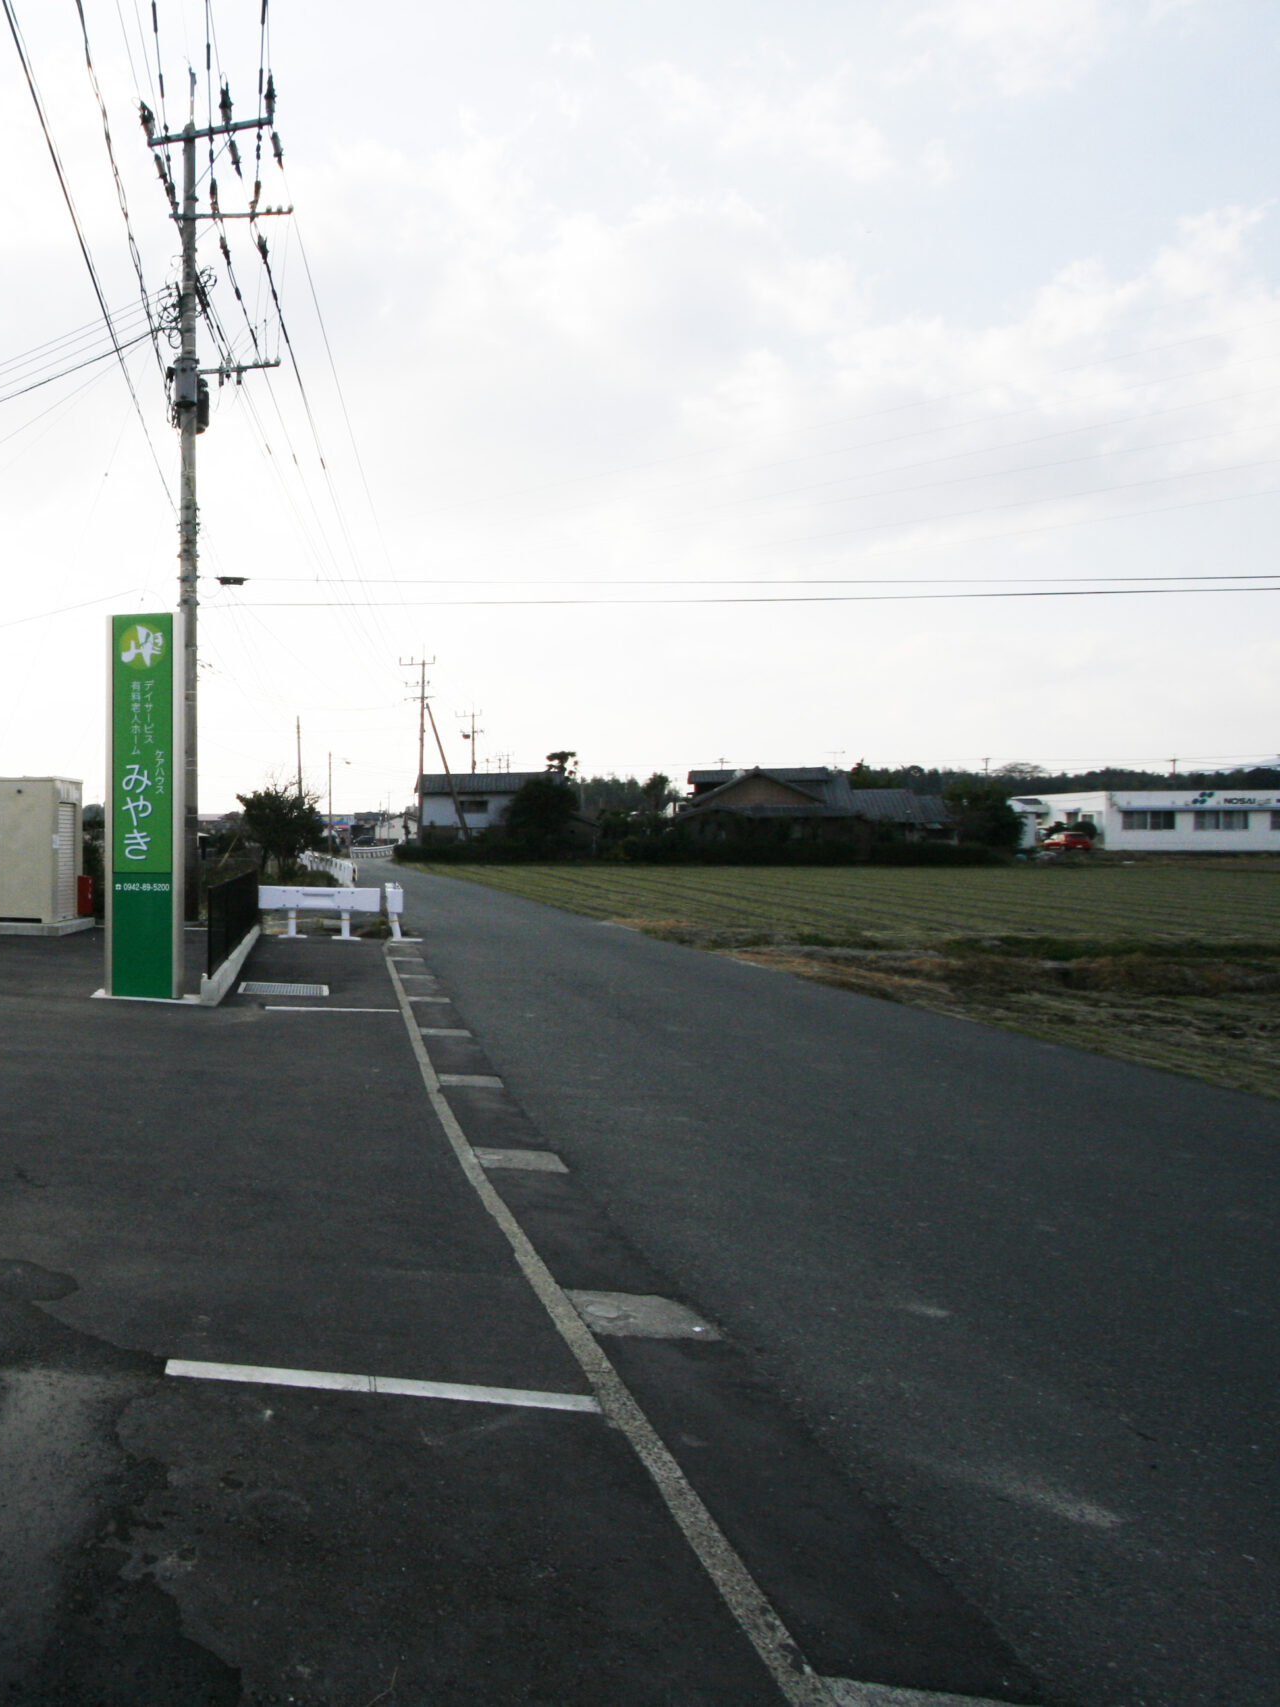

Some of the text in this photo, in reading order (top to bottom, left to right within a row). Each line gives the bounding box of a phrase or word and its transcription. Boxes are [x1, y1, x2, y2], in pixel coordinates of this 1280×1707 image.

[131, 681, 142, 755] 有料老人ホーム
[143, 680, 155, 744] デイサービス
[155, 750, 165, 794] ケアハウス
[122, 764, 152, 860] みやき
